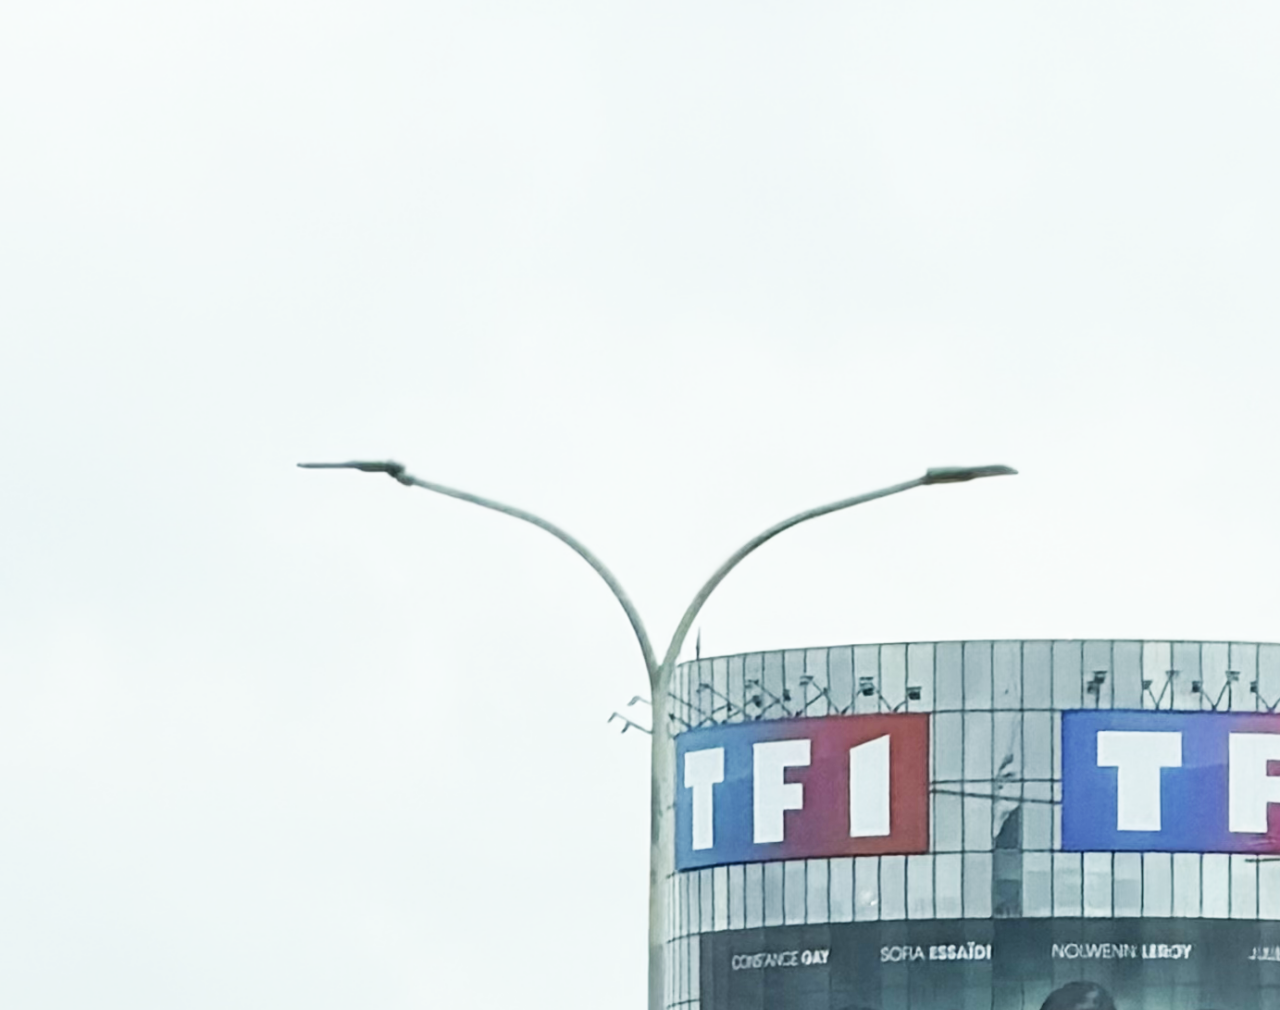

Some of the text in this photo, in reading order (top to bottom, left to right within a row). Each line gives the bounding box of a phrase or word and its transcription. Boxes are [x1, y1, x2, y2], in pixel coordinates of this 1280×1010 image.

[684, 733, 891, 851] TF1
[880, 941, 992, 962] SOFIA ESSAÏDI
[1051, 943, 1138, 959] NOLWENN
